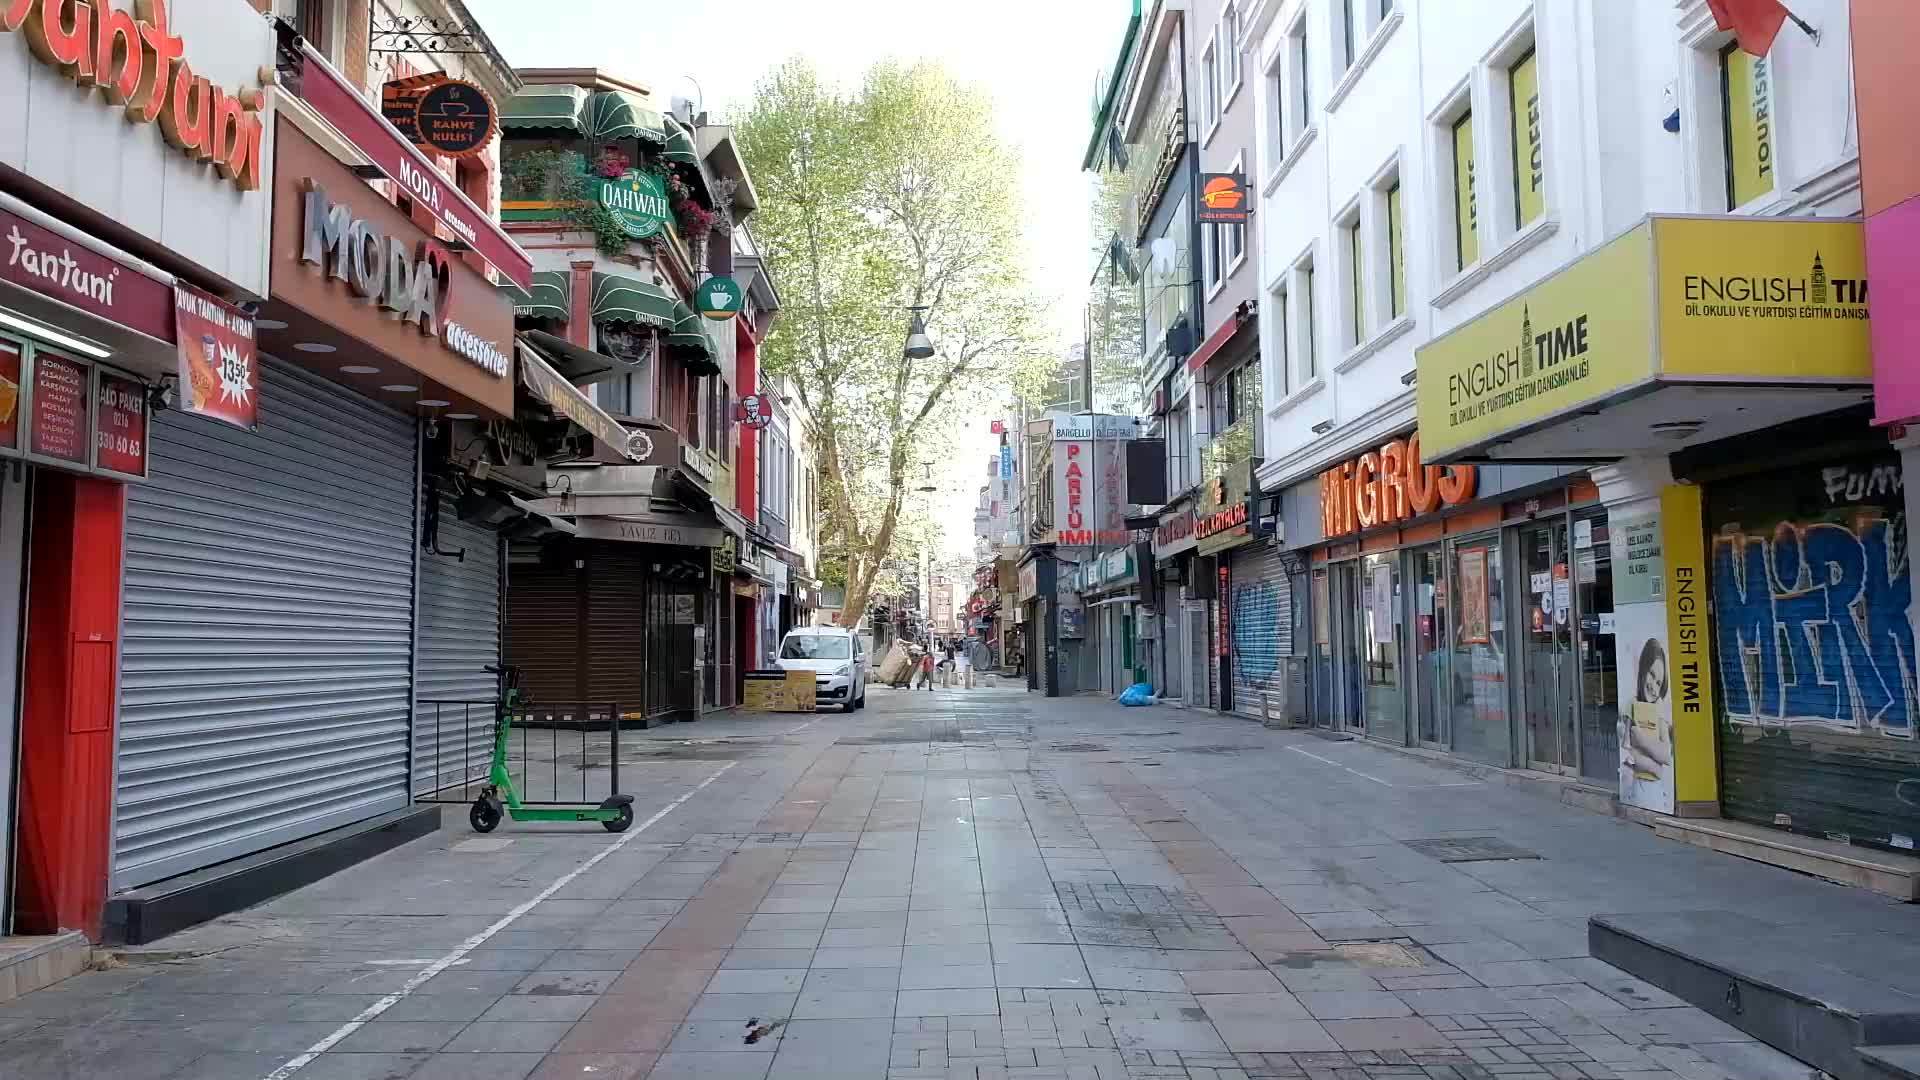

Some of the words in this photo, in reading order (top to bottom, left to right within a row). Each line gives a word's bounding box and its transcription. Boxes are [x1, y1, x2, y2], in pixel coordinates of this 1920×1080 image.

[399, 157, 440, 212] MODA
[444, 208, 476, 243] accessories
[603, 183, 667, 219] QAHWAH
[301, 187, 441, 337] MODA
[447, 321, 509, 378] accessories
[1684, 276, 1806, 302] ENGLISH
[1685, 303, 1700, 316] DİL
[1703, 305, 1736, 317] OKULU
[1738, 306, 1750, 317] VE
[1799, 305, 1832, 319] EĞİTİM
[232, 319, 253, 340] AYRAN
[42, 359, 79, 377] BORNOVA
[1449, 346, 1520, 406] ENGLISH
[1535, 314, 1588, 370] TIME
[101, 384, 117, 405] ALO
[119, 391, 143, 414] PAKET
[1459, 404, 1478, 423] OKULU
[1478, 401, 1486, 416] VE
[113, 411, 129, 428] 0216
[98, 431, 114, 450] 330
[117, 435, 127, 454] 60
[129, 439, 140, 457] 63
[1056, 429, 1091, 438] BARGELLO
[1677, 567, 1697, 654] ENGLISH
[1682, 661, 1700, 713] TIME
